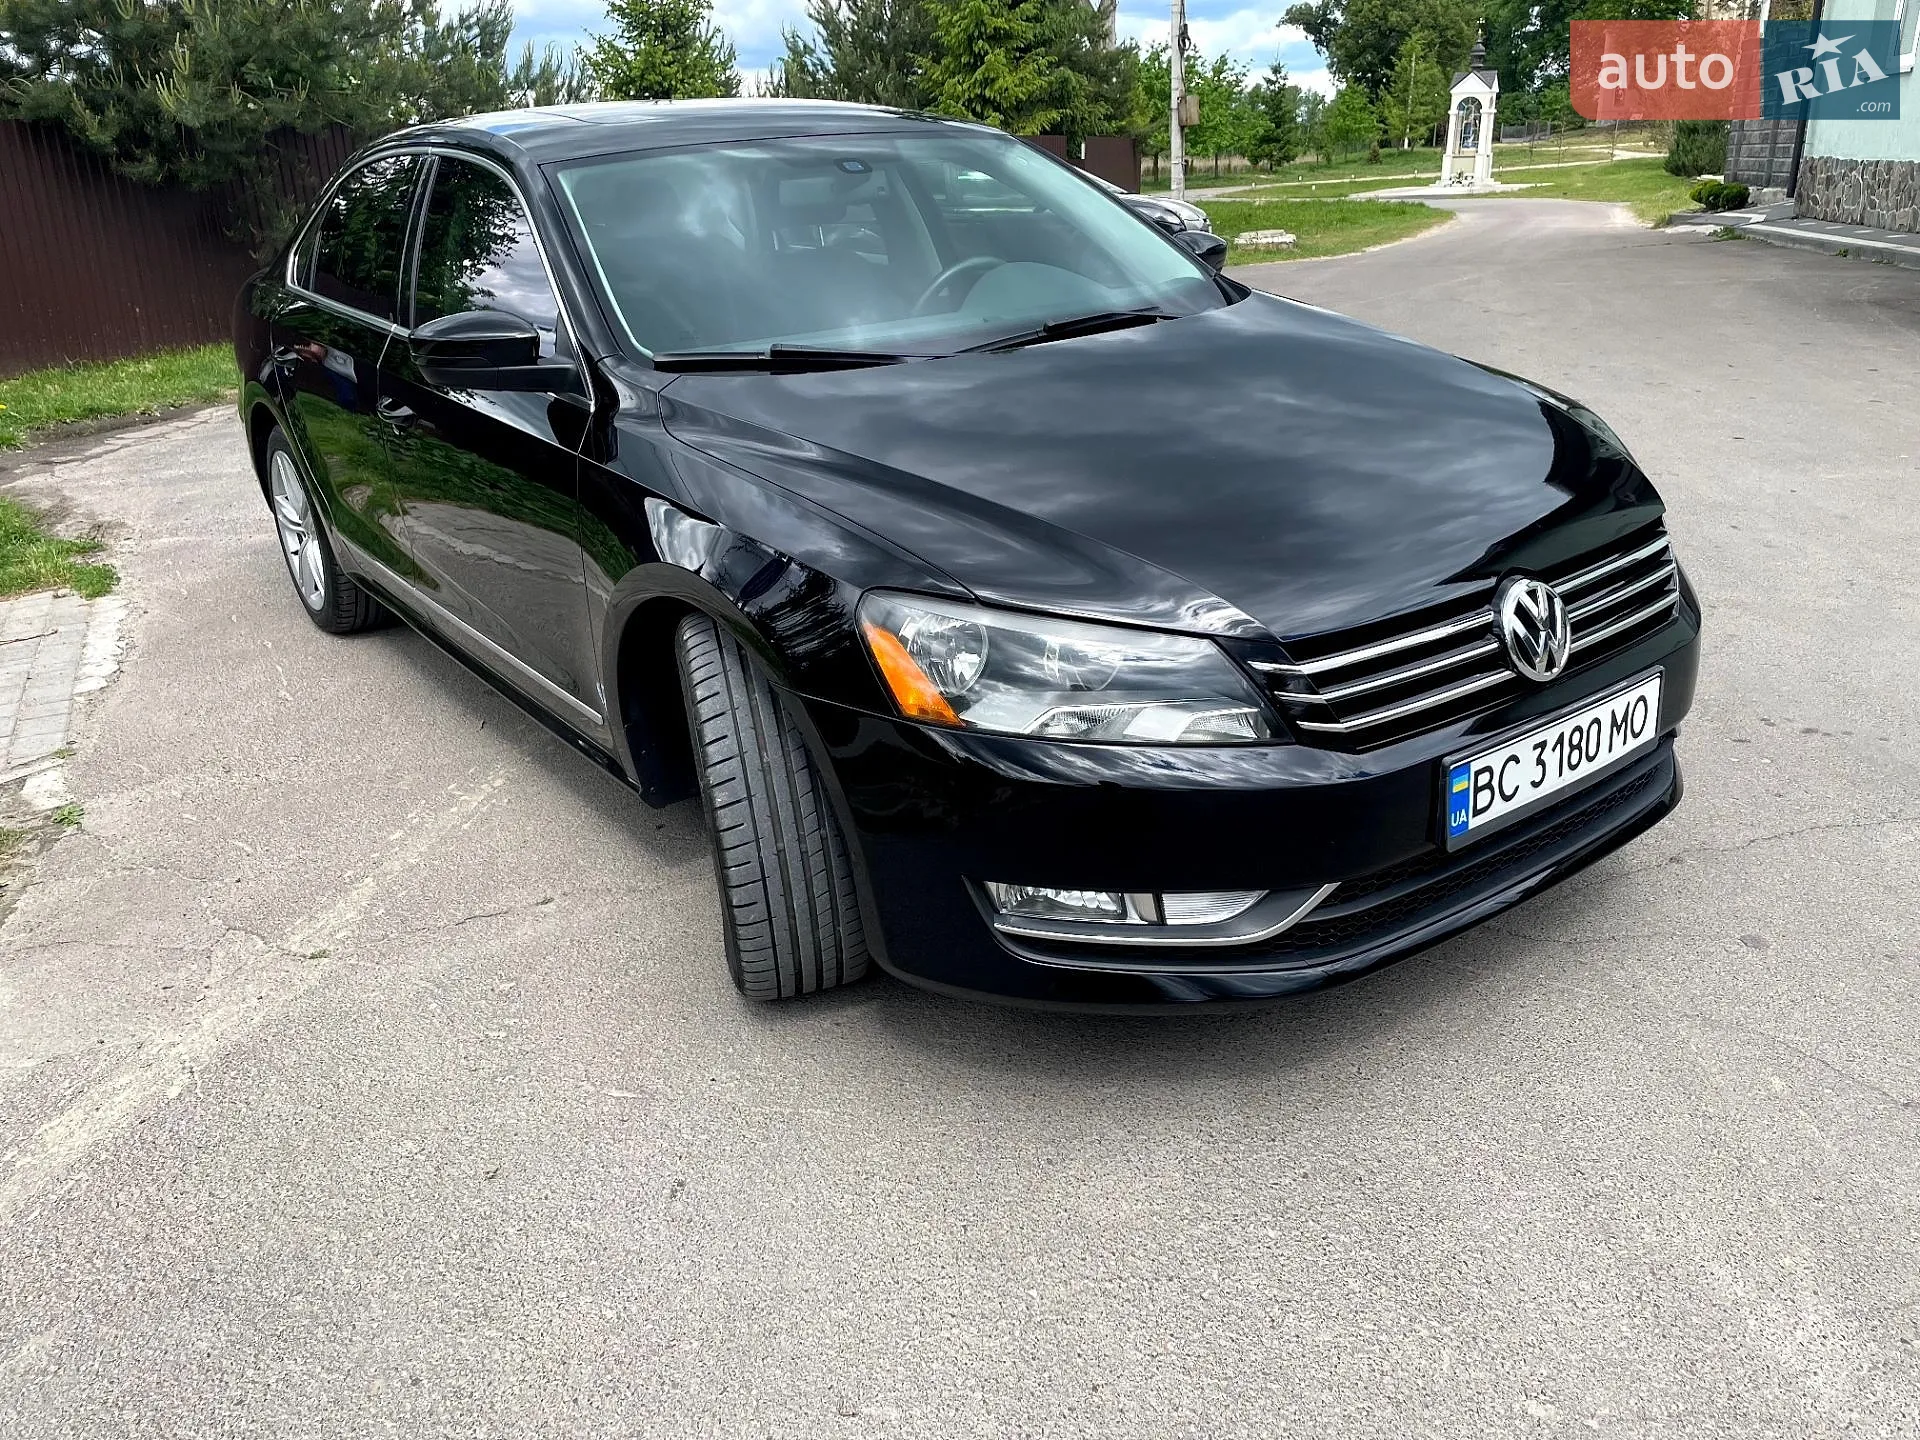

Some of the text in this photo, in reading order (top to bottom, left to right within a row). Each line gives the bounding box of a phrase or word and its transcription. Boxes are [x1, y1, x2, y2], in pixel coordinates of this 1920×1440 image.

[1472, 695, 1649, 818] BC 3180 MO
[1451, 809, 1467, 827] UA
